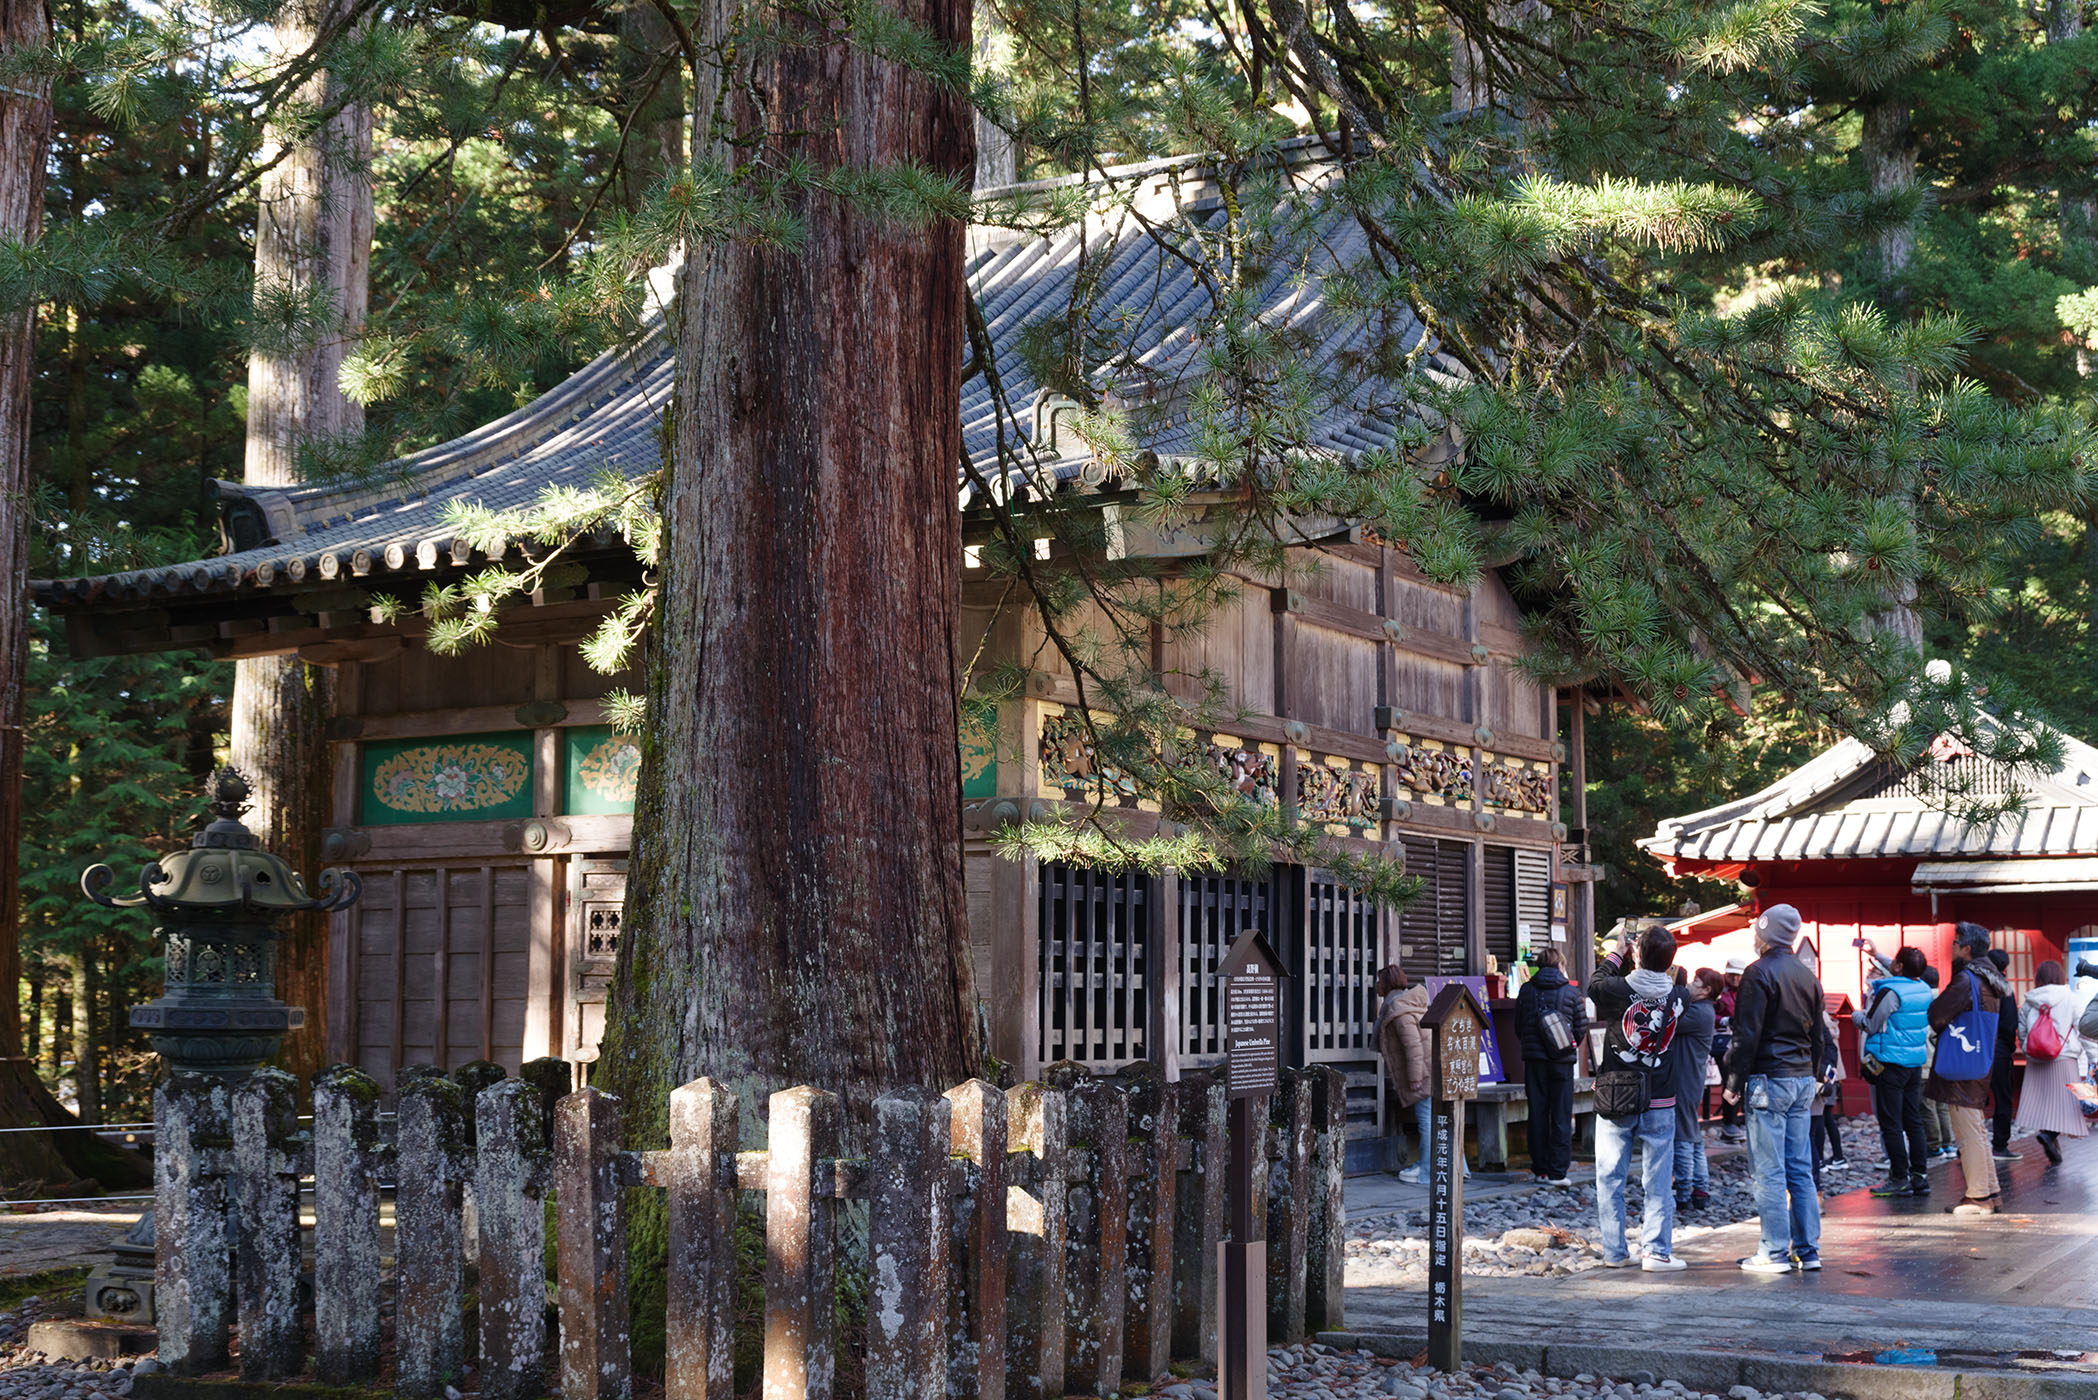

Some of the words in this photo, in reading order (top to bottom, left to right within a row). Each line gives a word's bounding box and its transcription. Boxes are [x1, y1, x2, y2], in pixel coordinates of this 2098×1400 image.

[1446, 1077, 1476, 1094] こうやまき
[1434, 1115, 1448, 1266] 平成元年六月十五日指定
[1433, 1281, 1446, 1323] 栃木県
